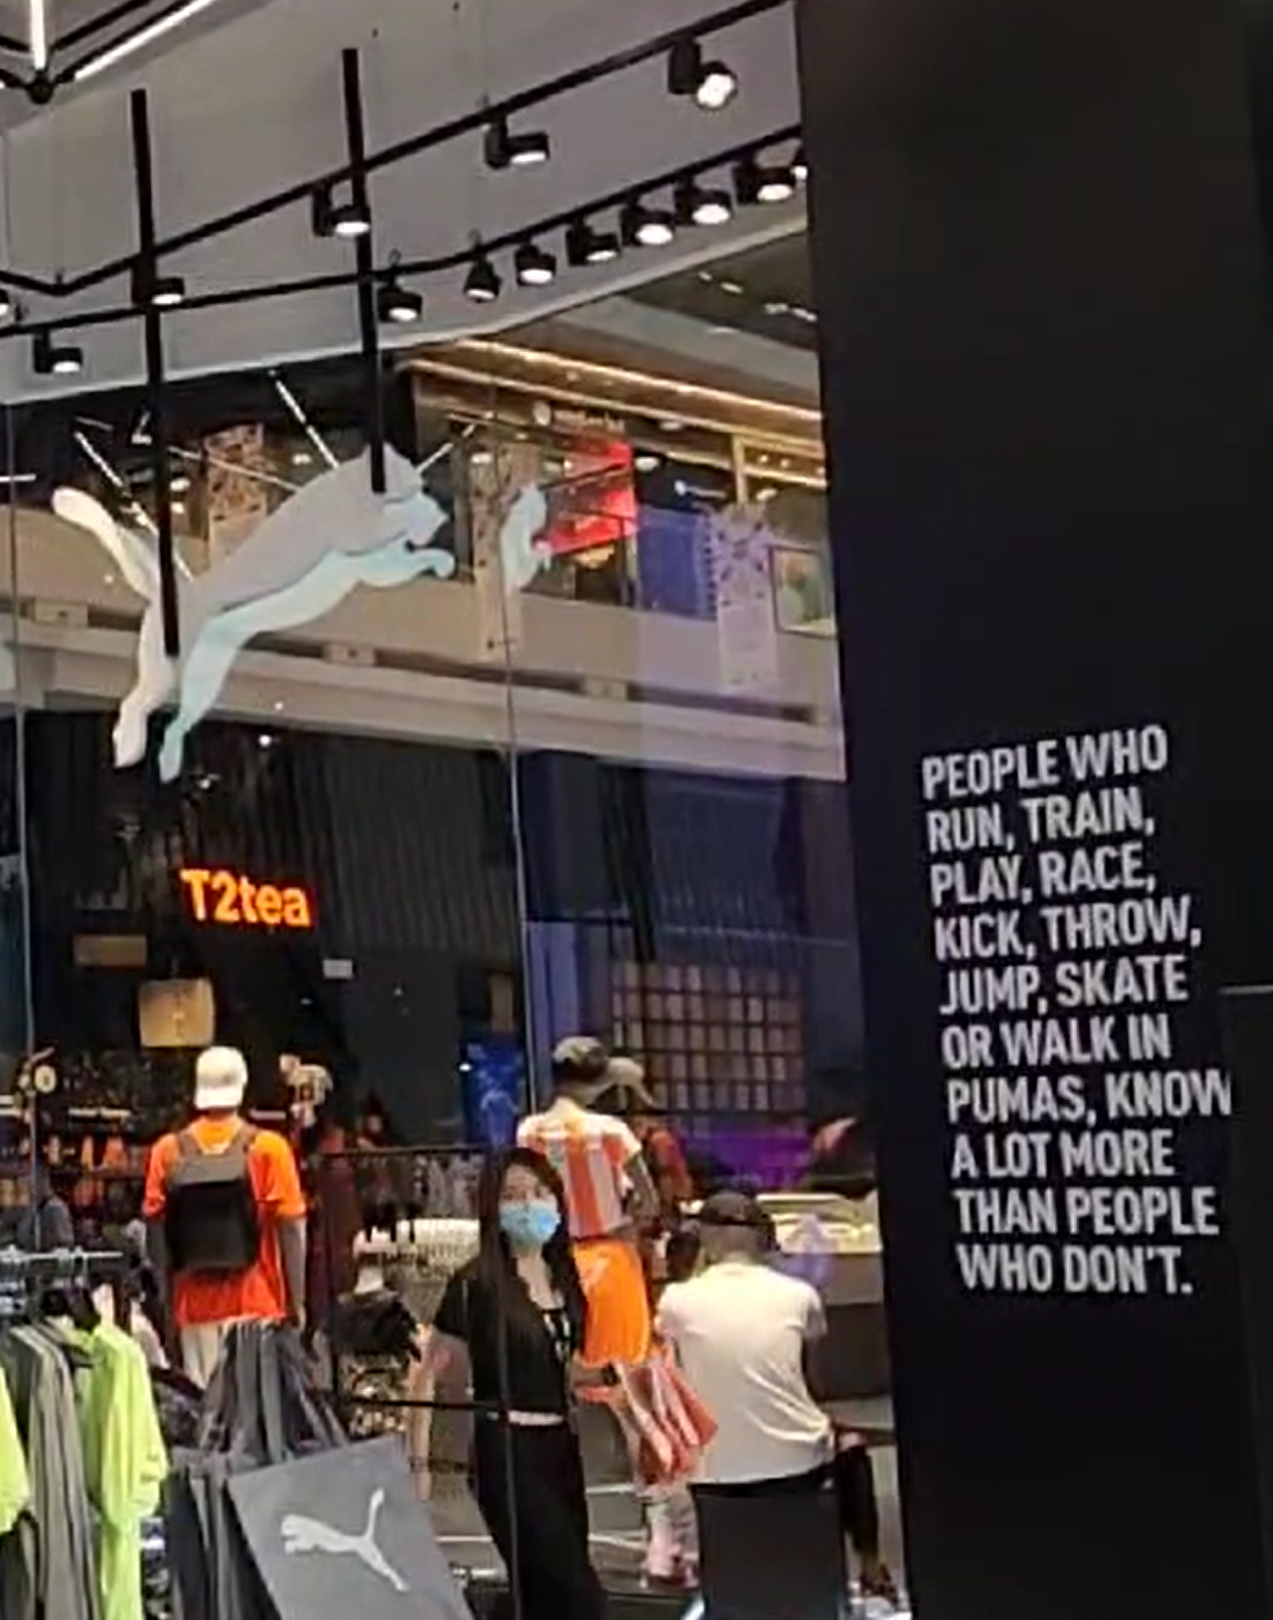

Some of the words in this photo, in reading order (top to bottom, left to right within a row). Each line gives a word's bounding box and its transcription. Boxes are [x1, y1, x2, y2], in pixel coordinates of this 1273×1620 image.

[922, 740, 1060, 800] PEOPLE
[1066, 725, 1168, 781] WHO
[926, 803, 1014, 853] RUN,
[1021, 786, 1155, 843] TRAIN,
[179, 869, 311, 927] T2tea
[930, 854, 1032, 907] PLAY,
[1039, 841, 1156, 897] RACE,
[934, 909, 1036, 961] KICK,
[1039, 895, 1202, 950] THROW,
[939, 964, 1048, 1015] JUMP,
[1055, 954, 1188, 1007] SKATE
[941, 1024, 995, 1069] OR
[999, 1015, 1119, 1066] WALK
[1127, 1013, 1171, 1061] IN
[947, 1074, 1096, 1127] PUMAS,
[1104, 1068, 1232, 1119] KNOW
[951, 1133, 978, 1178] A
[986, 1132, 1051, 1178] LOT
[1059, 1128, 1175, 1178] MORE
[952, 1187, 1058, 1234] THAN
[1065, 1186, 1220, 1235] PEOPLE
[956, 1243, 1053, 1292] WHO
[1063, 1244, 1193, 1294] DON'T.
